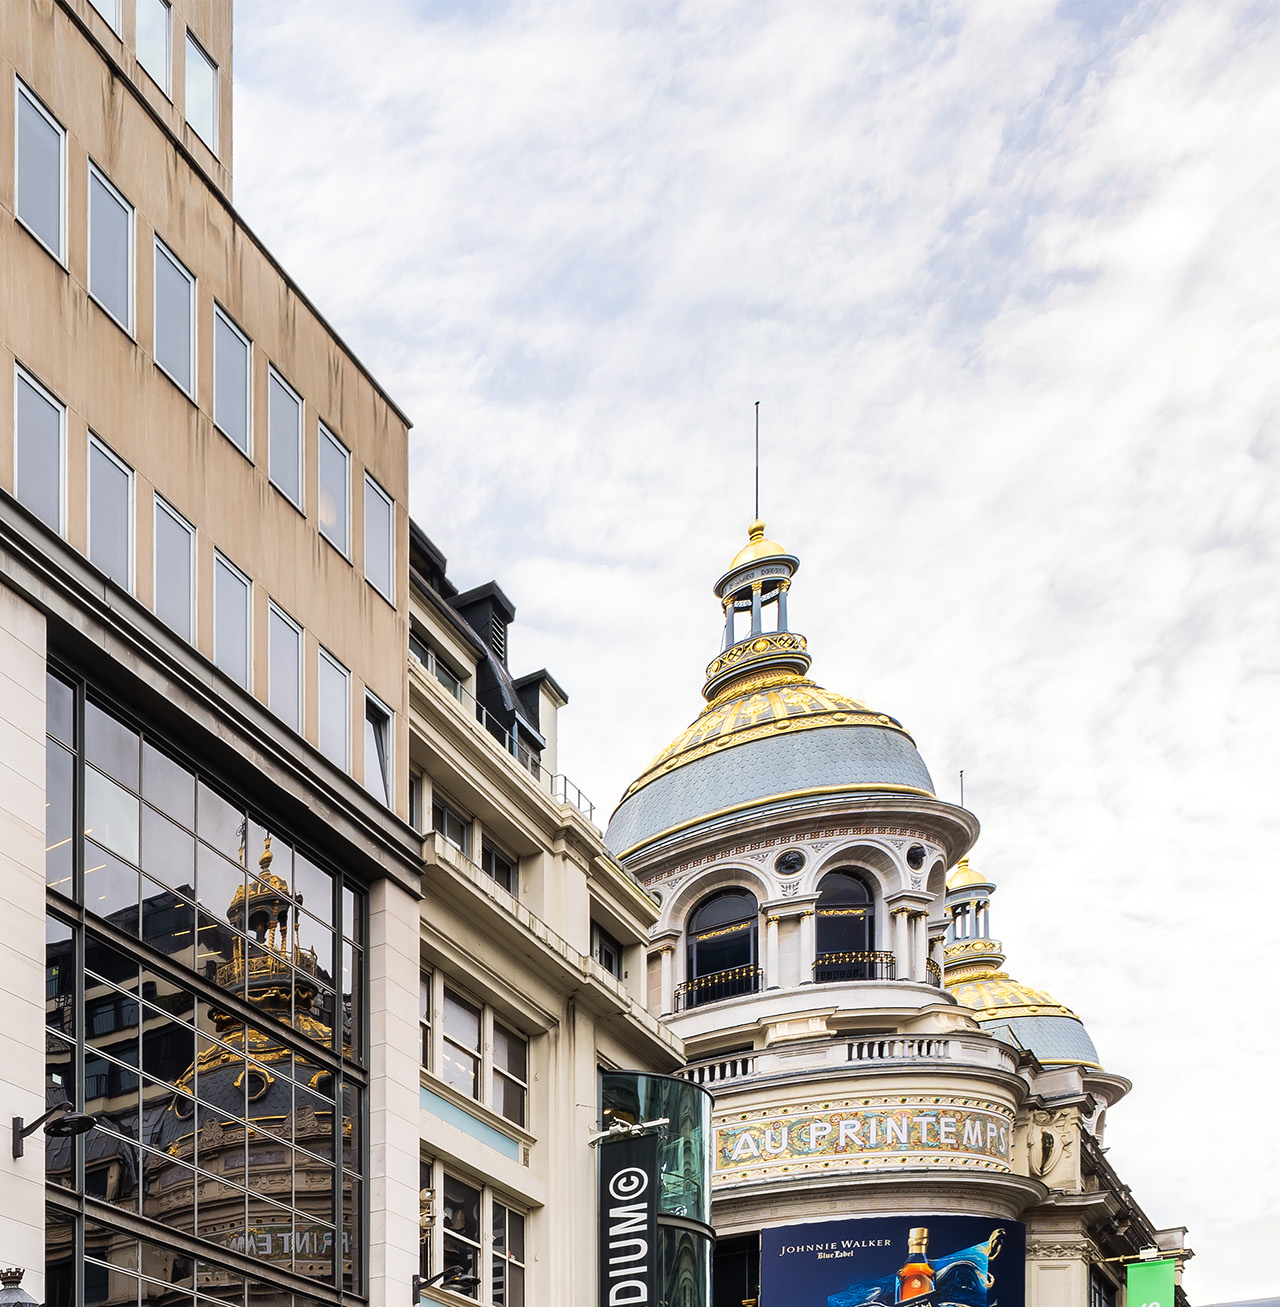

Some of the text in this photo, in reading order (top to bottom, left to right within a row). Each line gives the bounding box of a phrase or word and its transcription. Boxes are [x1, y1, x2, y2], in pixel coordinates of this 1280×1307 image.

[730, 1115, 1008, 1161] AU PRINTEMPS
[779, 1239, 891, 1257] JOHNNIE WALKER
